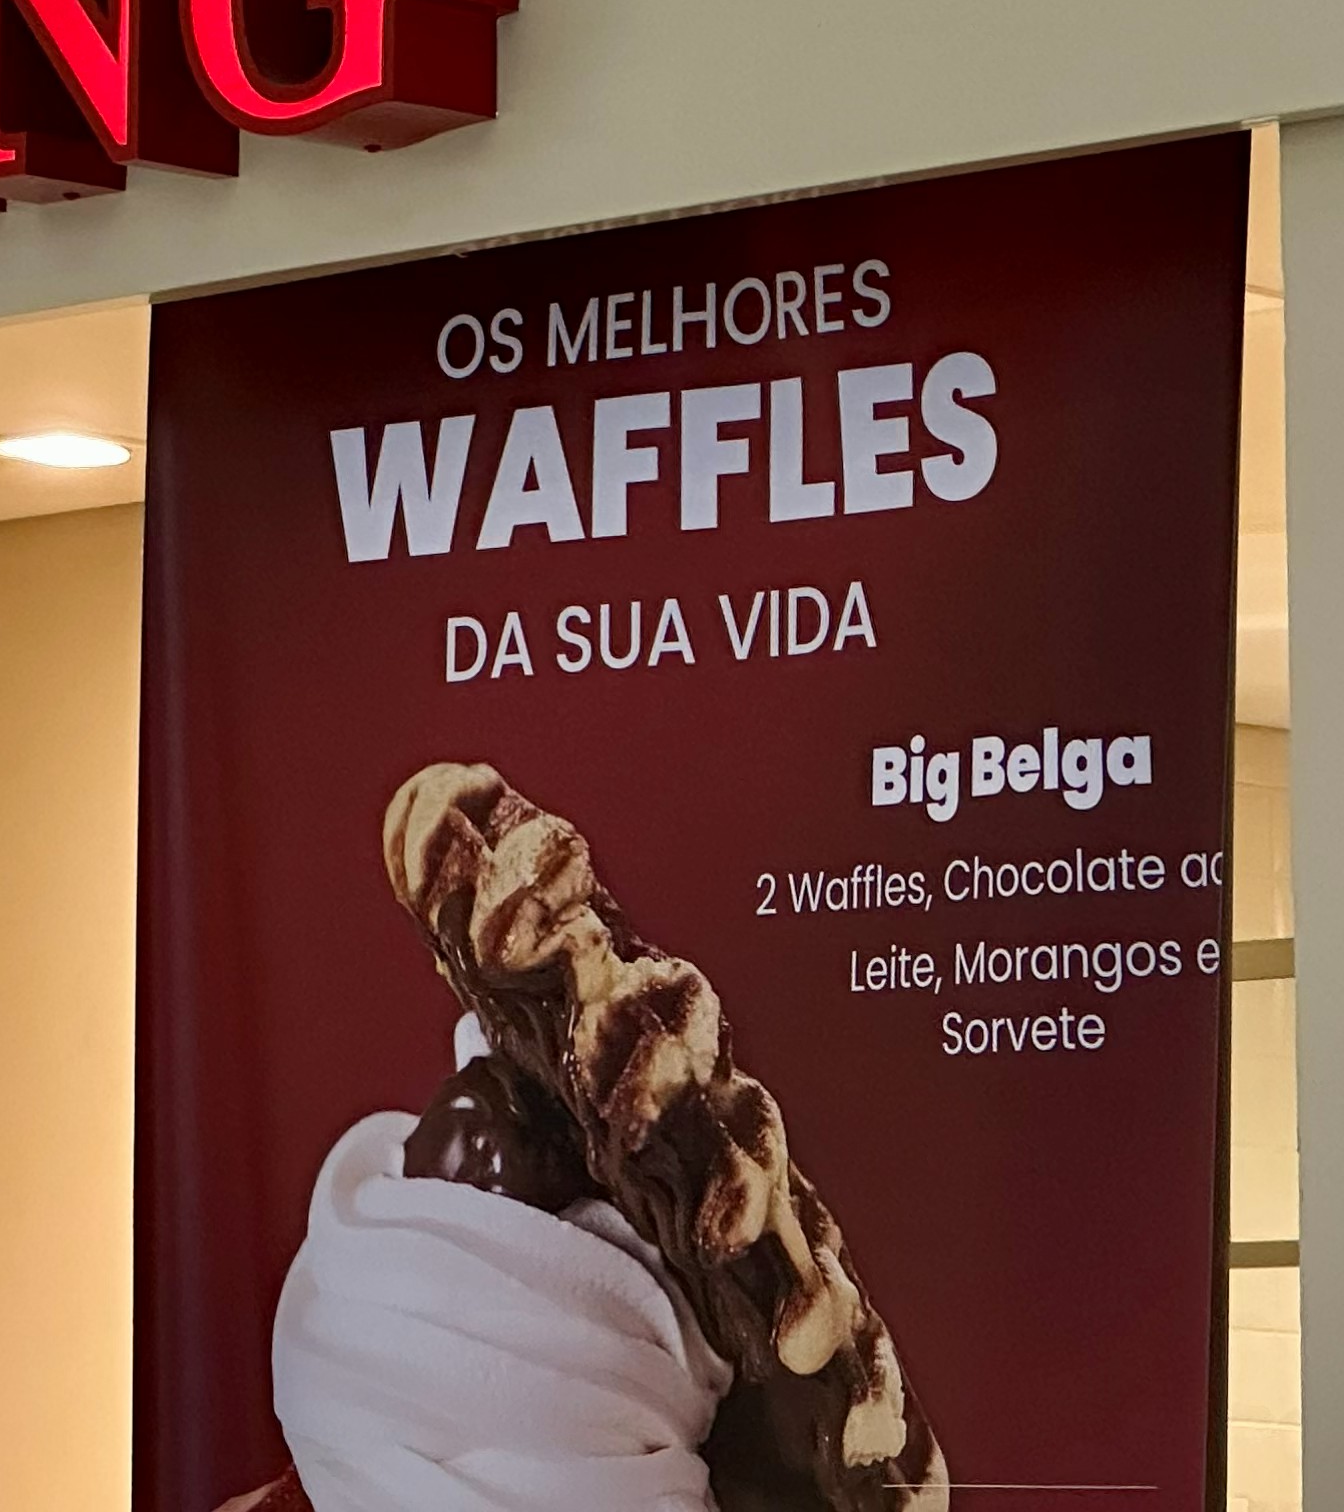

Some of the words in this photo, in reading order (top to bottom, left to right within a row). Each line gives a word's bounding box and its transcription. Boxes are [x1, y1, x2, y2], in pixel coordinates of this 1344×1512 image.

[436, 308, 524, 379] OS
[547, 259, 892, 367] MELHORES
[329, 351, 999, 563] WAFFLES
[444, 610, 535, 684] DA
[555, 597, 697, 674] SUA
[717, 580, 878, 661] VIDA
[871, 734, 960, 823] Big
[971, 726, 1152, 811] Belga
[755, 872, 777, 916] 2
[787, 863, 933, 913] Waffles,
[943, 847, 1166, 901] Chocolate
[850, 947, 943, 995] Leite,
[954, 940, 1182, 993] Morangos
[1196, 938, 1221, 974] e
[942, 1006, 1106, 1055] Sorvete
